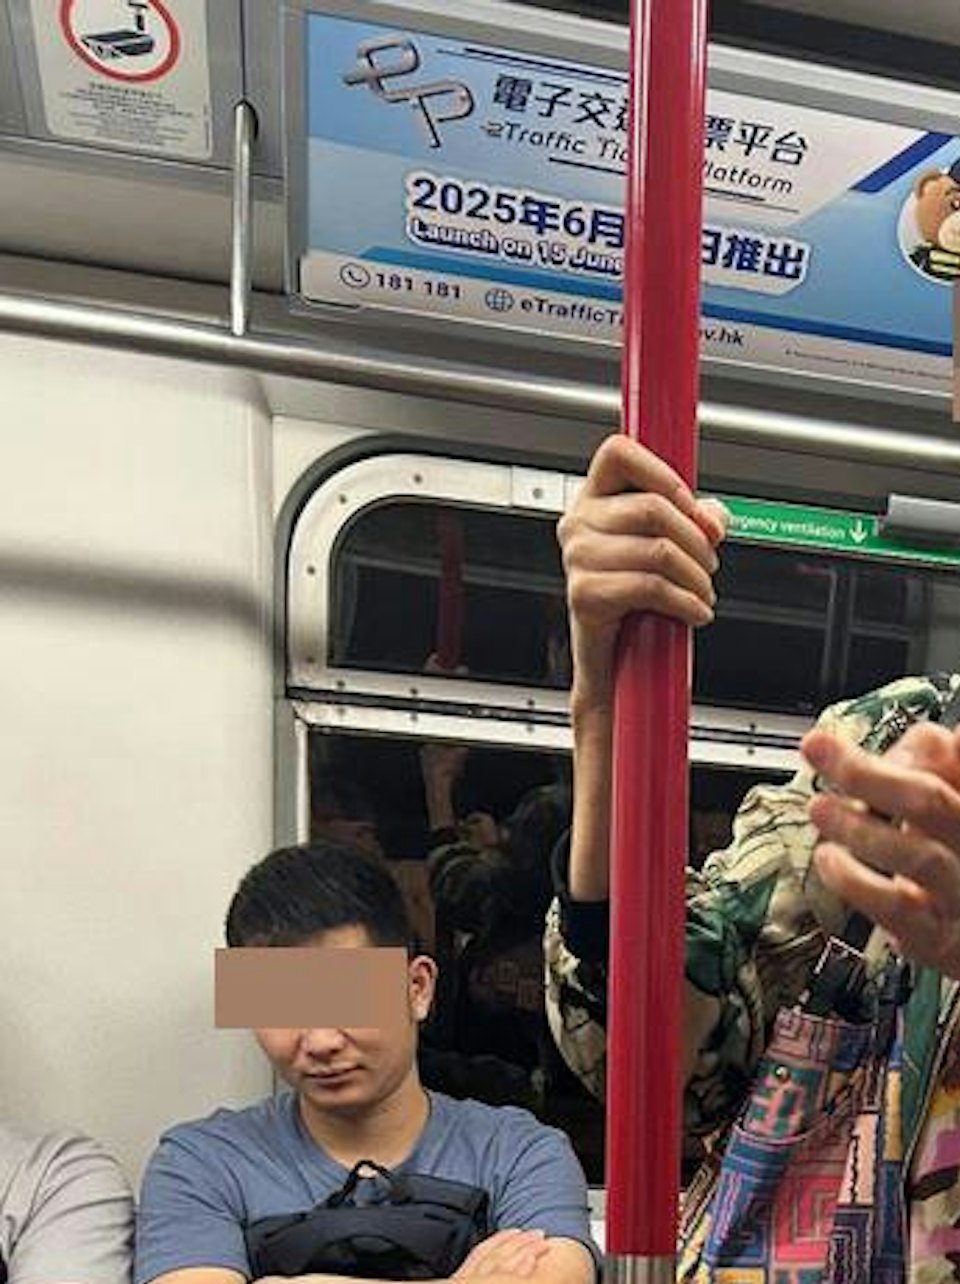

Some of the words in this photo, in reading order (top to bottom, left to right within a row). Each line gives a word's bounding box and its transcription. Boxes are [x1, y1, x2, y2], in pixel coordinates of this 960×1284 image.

[703, 160, 793, 193] latform
[409, 218, 498, 254] Launch
[502, 237, 531, 260] on
[376, 273, 412, 291] 181
[424, 281, 460, 299] 181
[780, 519, 845, 540] ventilation
